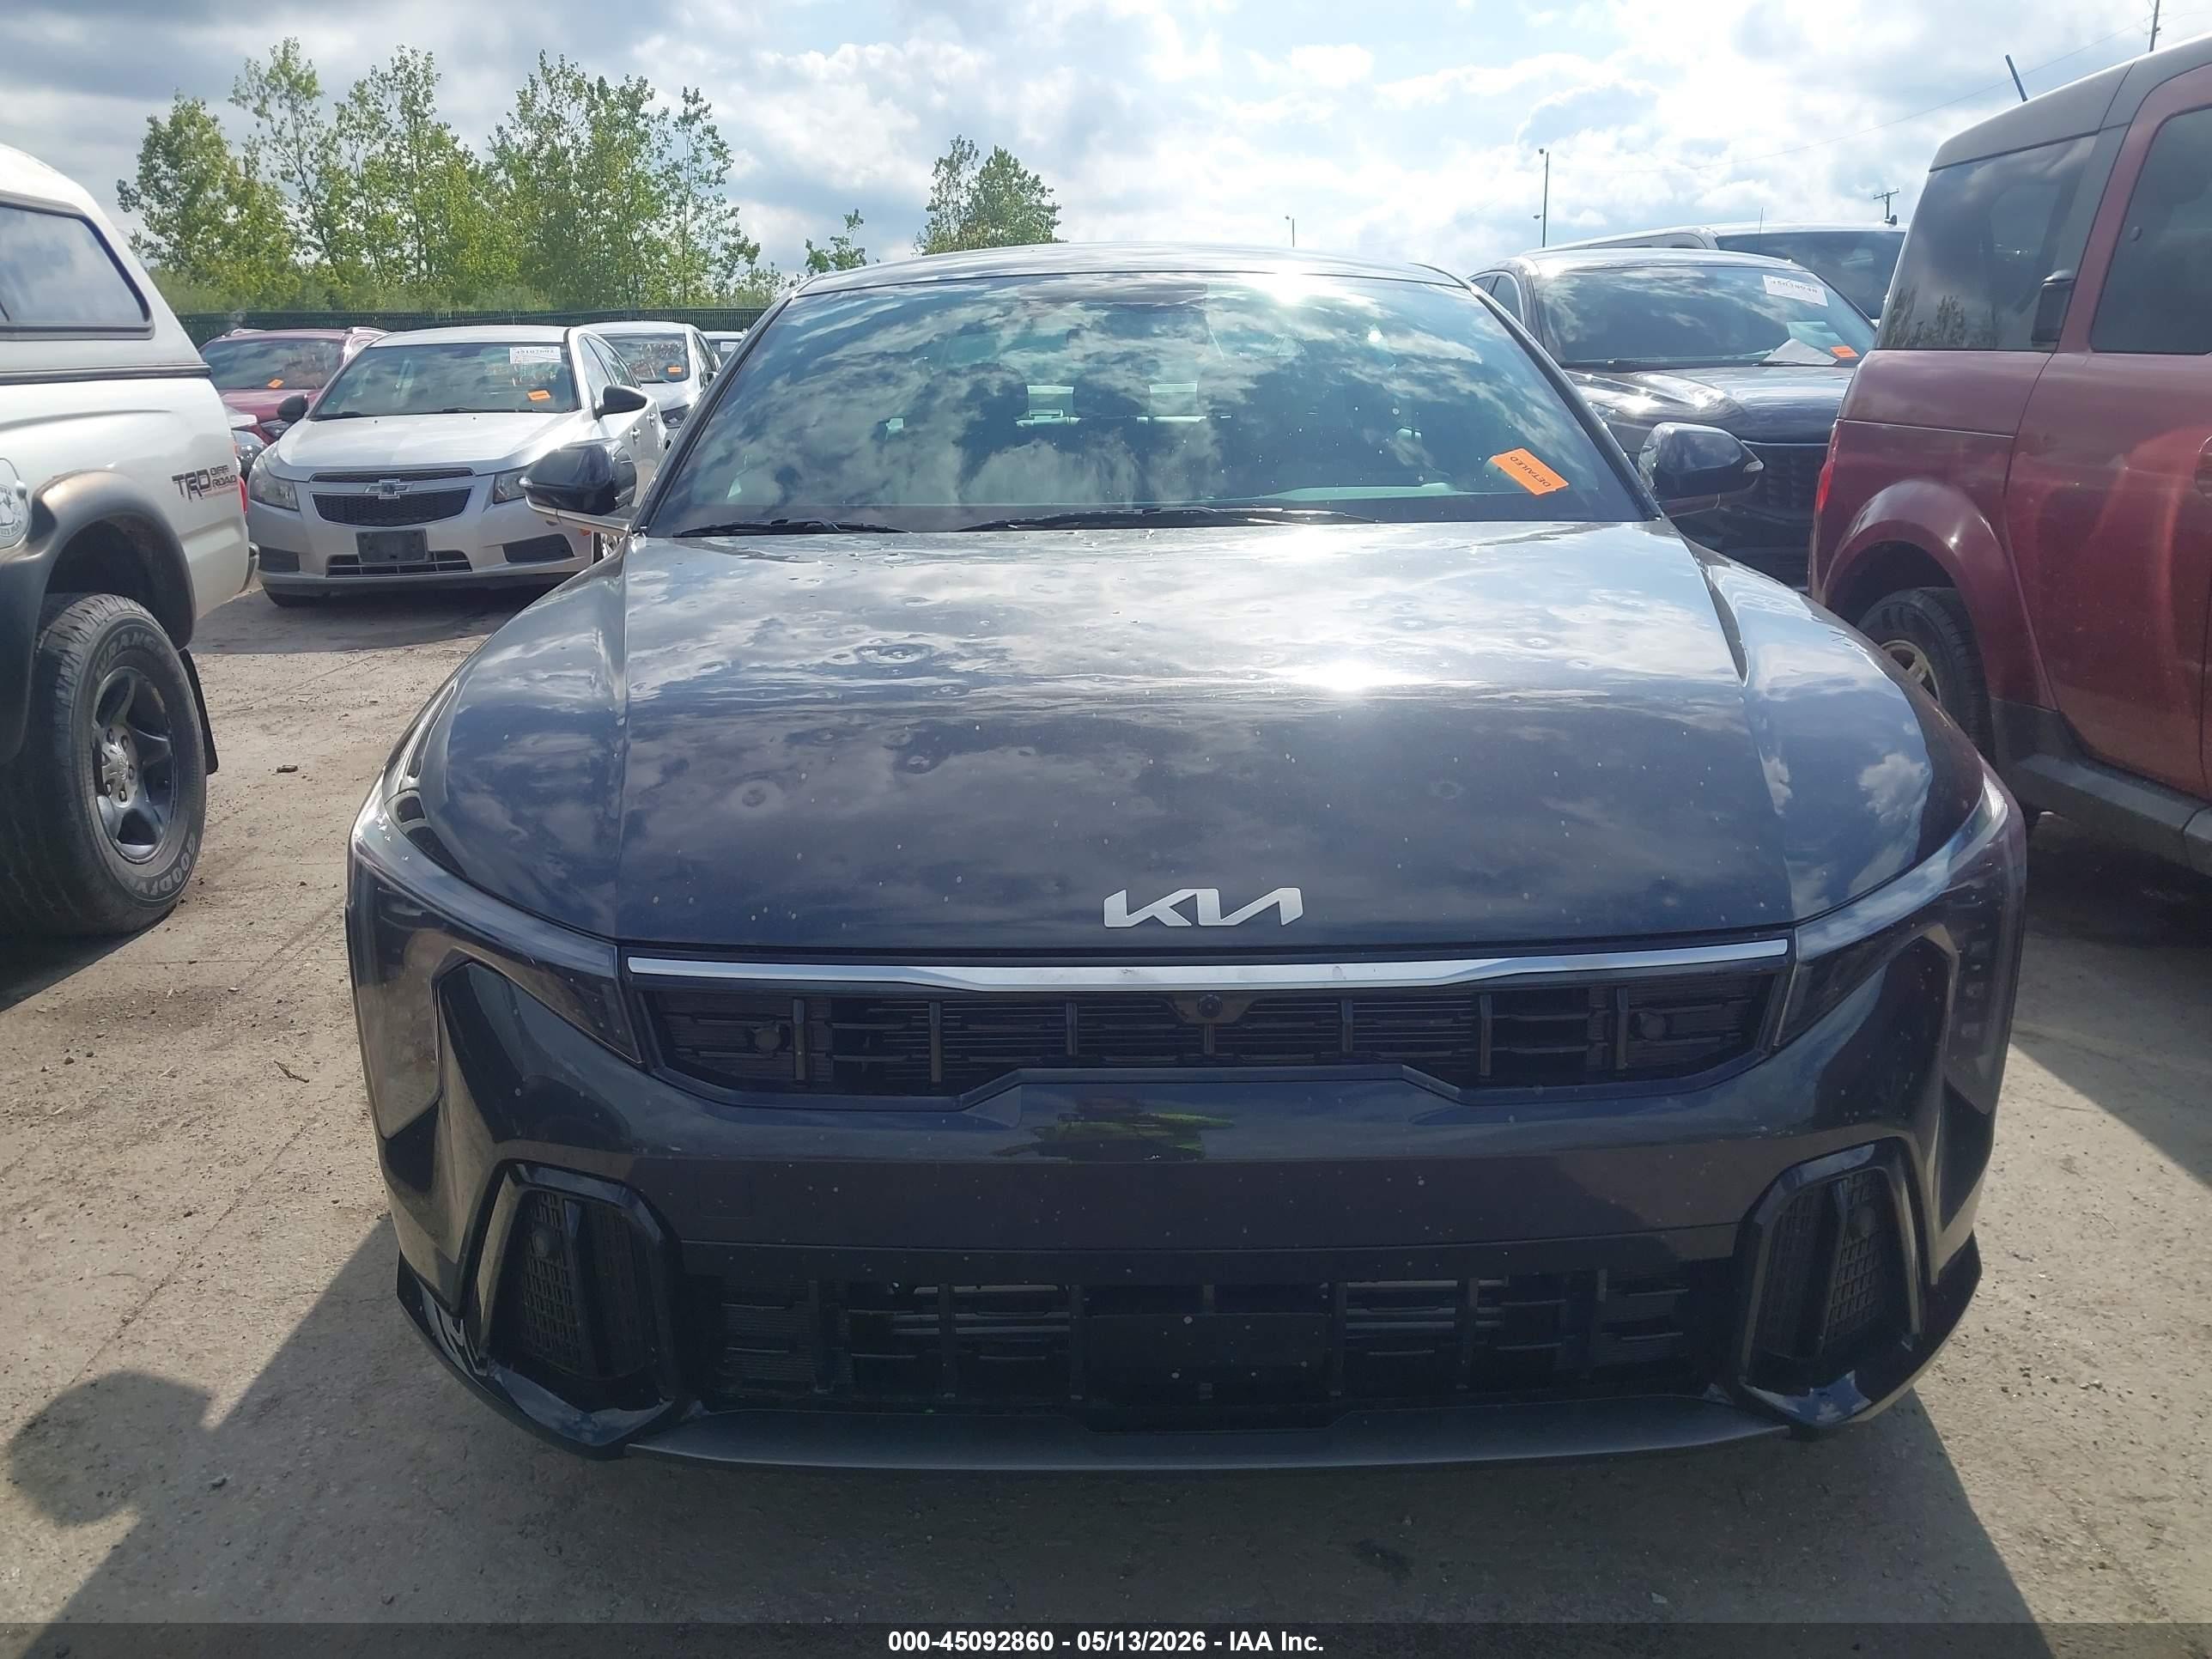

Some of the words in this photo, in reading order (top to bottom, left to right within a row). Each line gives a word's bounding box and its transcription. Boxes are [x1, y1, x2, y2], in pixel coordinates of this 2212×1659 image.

[171, 469, 210, 501] TRD
[210, 465, 228, 476] OFF
[212, 475, 237, 488] ROAD
[1510, 455, 1552, 488] DETAILED
[1103, 888, 1304, 928] KIA
